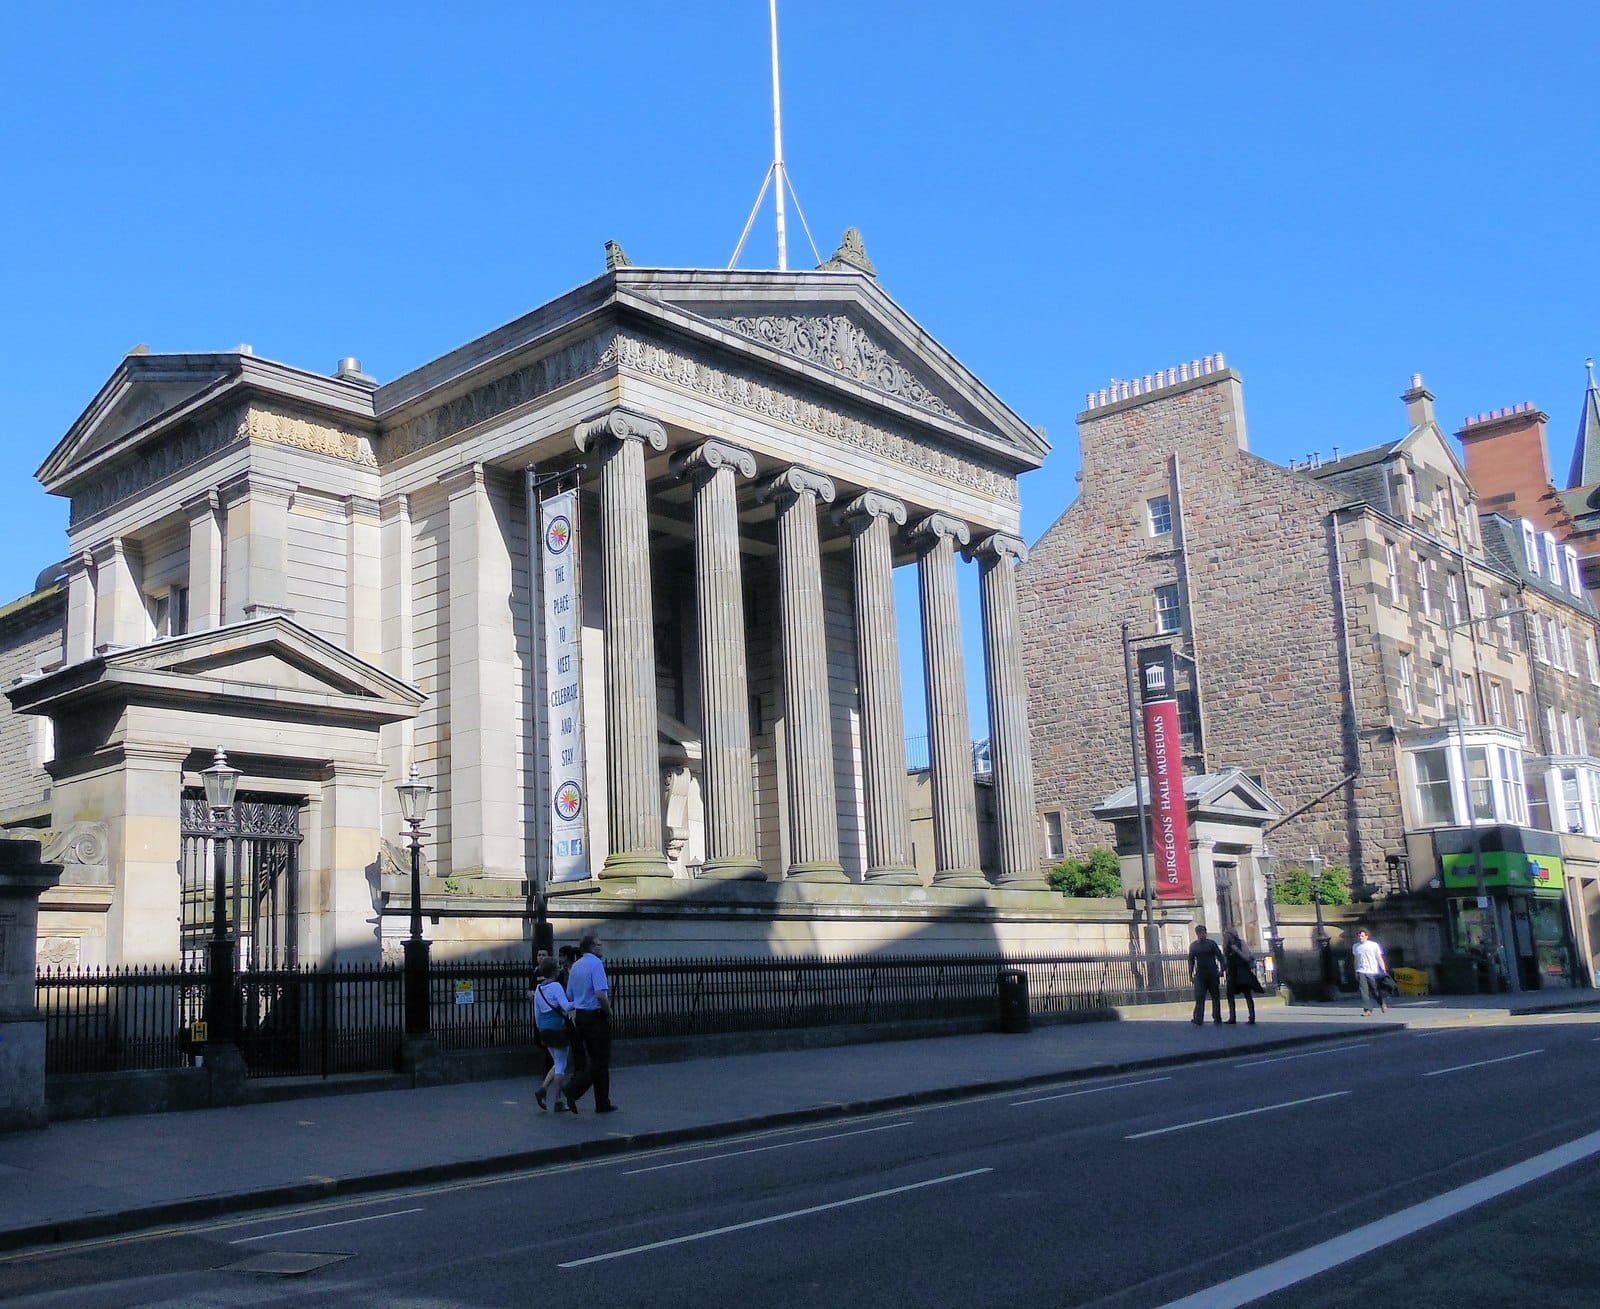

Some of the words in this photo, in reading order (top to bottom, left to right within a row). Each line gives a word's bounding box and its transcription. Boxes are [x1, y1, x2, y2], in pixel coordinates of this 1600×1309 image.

[554, 566, 565, 585] THE
[553, 594, 569, 615] PLACE
[559, 626, 566, 643] TO
[557, 655, 571, 675] MEET
[551, 683, 578, 708] CELEBRATE
[560, 716, 572, 736] AND
[1153, 715, 1168, 775] MUSEUMS
[561, 748, 574, 767] STAY
[1159, 778, 1171, 810] HALL
[1161, 815, 1179, 884] SURGEONS'
[194, 1023, 205, 1040] H
